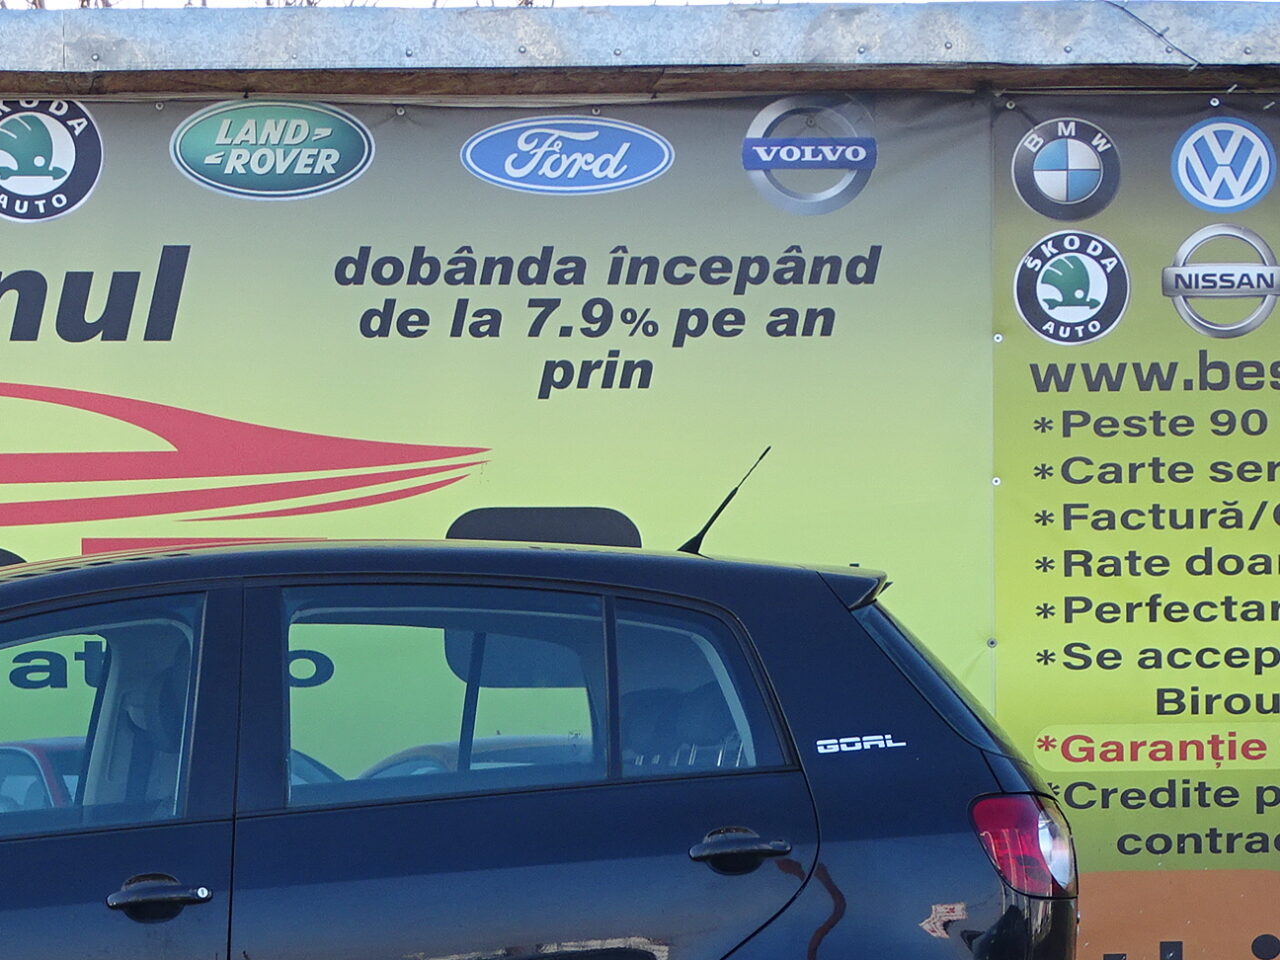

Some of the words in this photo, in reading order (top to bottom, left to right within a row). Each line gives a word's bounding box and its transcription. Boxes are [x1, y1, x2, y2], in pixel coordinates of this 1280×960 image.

[215, 119, 311, 145] LAND
[1023, 121, 1111, 153] BMW
[223, 148, 341, 175] ROVER
[504, 128, 631, 180] Ford
[751, 145, 867, 163] VOLVO
[334, 246, 587, 286] dobânda
[606, 244, 883, 296] începând
[1174, 272, 1275, 290] NISSAN
[359, 297, 430, 339] de
[449, 297, 503, 338] la
[672, 305, 747, 348] pe
[765, 306, 837, 337] an
[1042, 320, 1102, 338] AUTO
[537, 349, 654, 400] prin
[1210, 408, 1268, 437] 90
[1185, 546, 1280, 577] doa
[1137, 646, 1280, 676] accep
[1156, 686, 1280, 716] Birou
[816, 734, 907, 754] GOAL
[1116, 827, 1280, 856] contra
